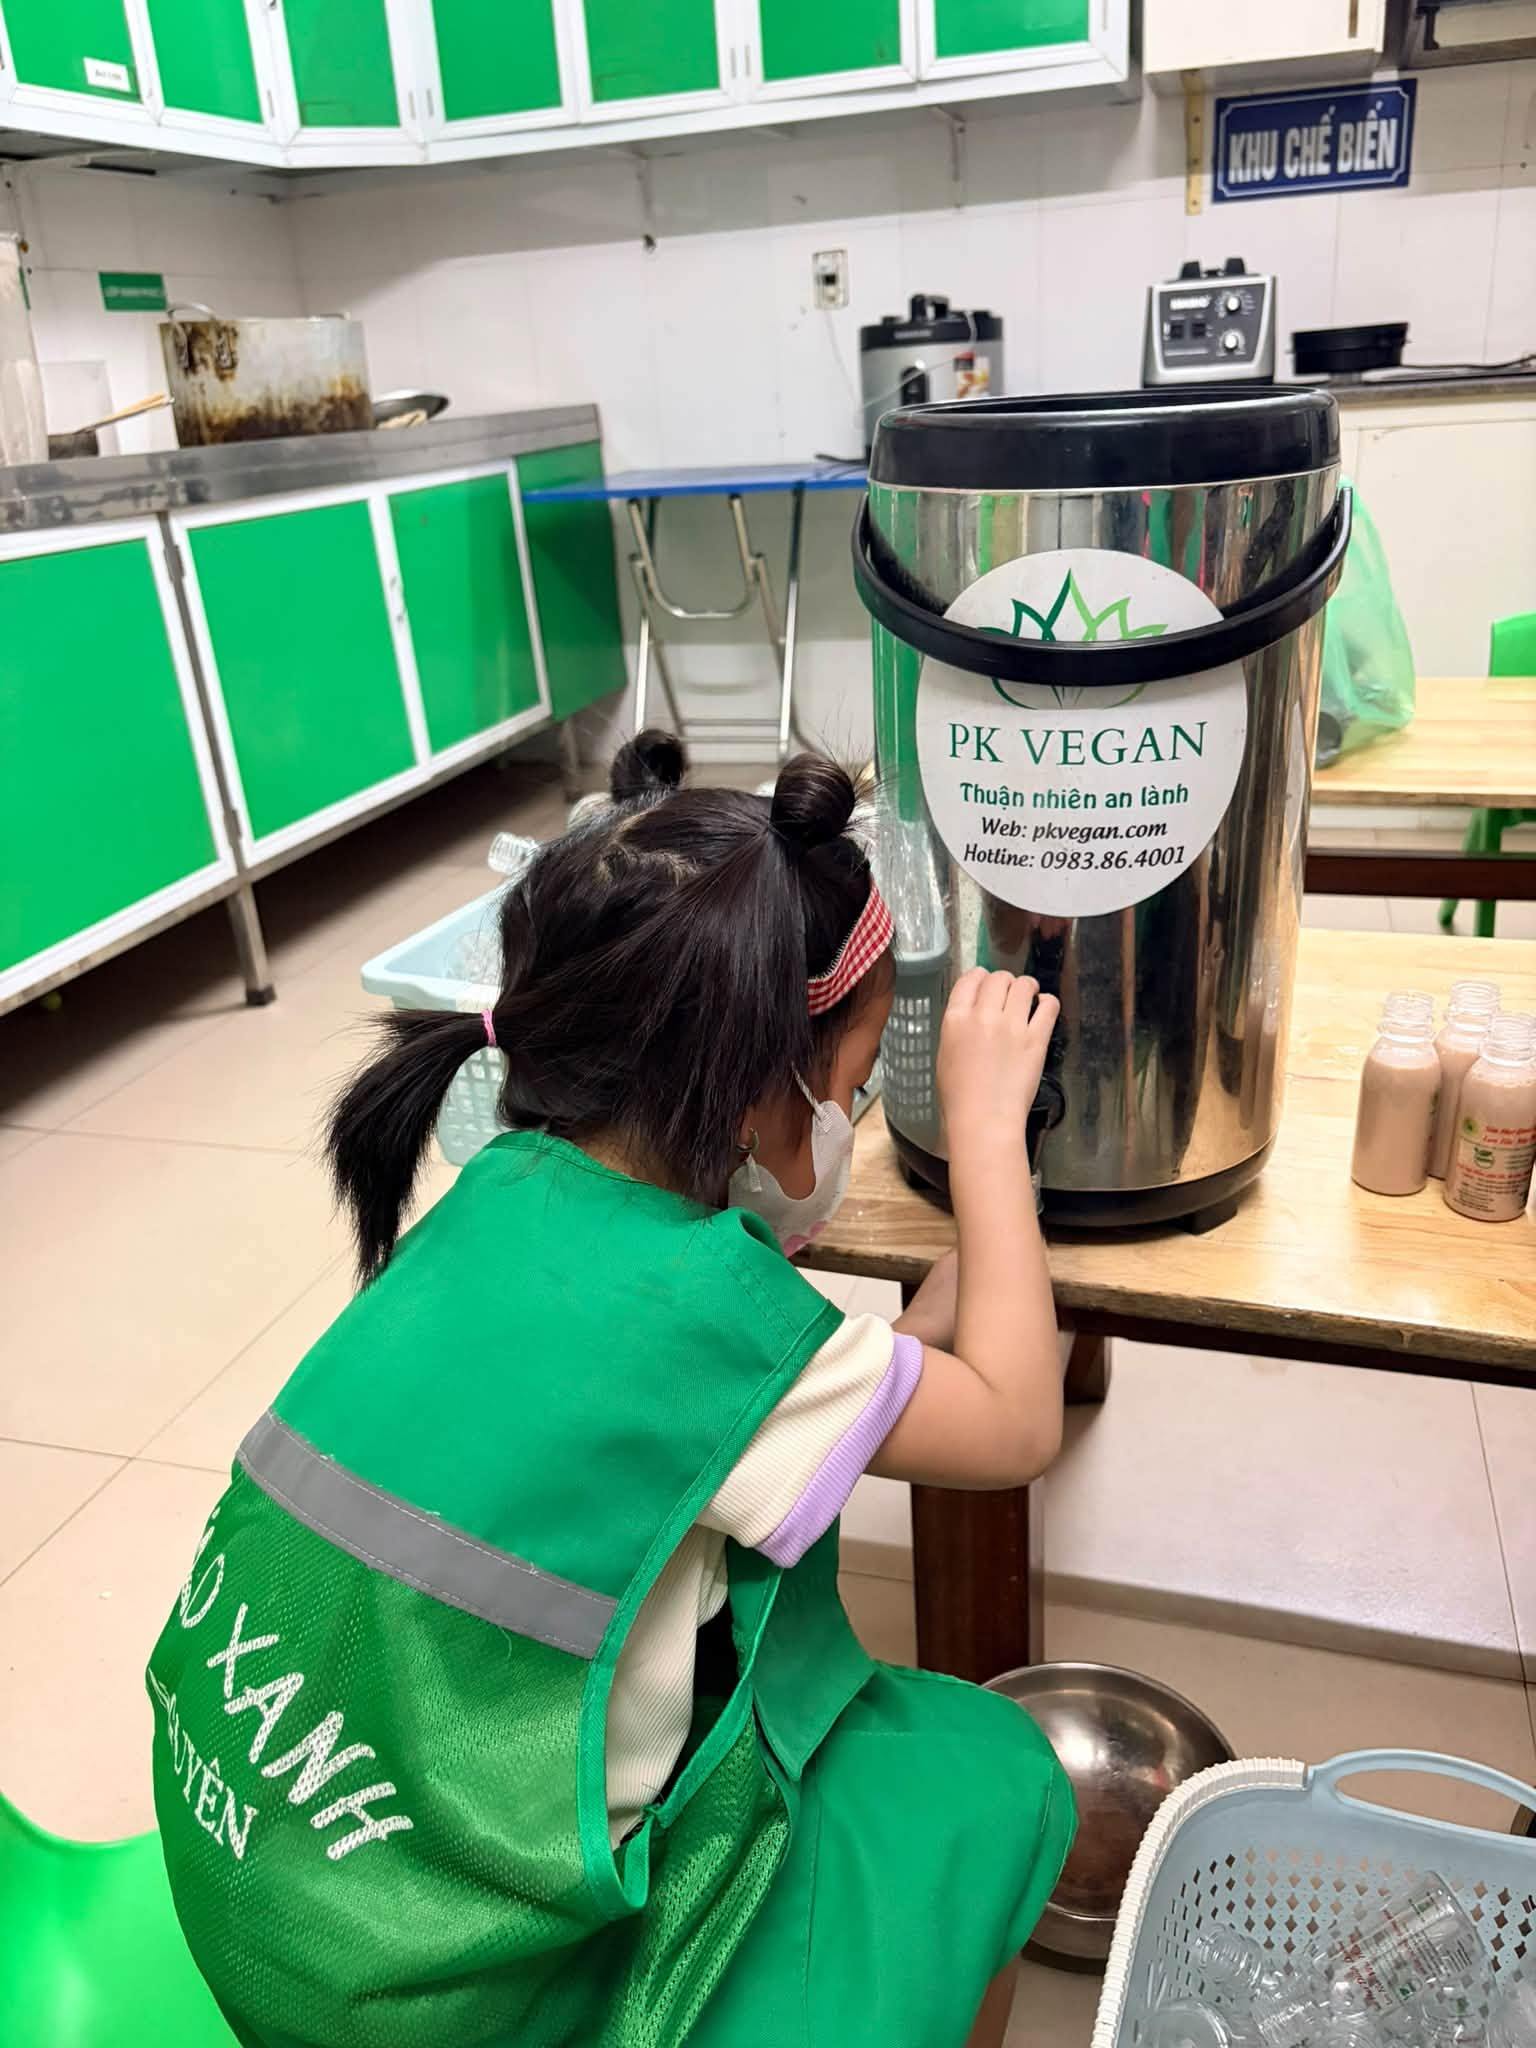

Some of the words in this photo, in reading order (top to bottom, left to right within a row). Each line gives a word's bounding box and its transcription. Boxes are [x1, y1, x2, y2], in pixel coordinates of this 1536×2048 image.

[1228, 130, 1279, 184] KHU
[1283, 105, 1336, 179] CHẾ
[1337, 100, 1399, 175] BIẾN
[948, 722, 1004, 764] PK
[1020, 721, 1208, 766] VEGAN
[960, 782, 1024, 812] Thuận
[1032, 787, 1097, 809] nhiên
[1105, 791, 1132, 809] an
[1140, 783, 1189, 808] lành
[981, 816, 1027, 839] Web:
[1032, 820, 1168, 844] pkvegan.com
[964, 844, 1035, 869] Hotline:
[1041, 845, 1184, 870] 0983.86.4001
[207, 1603, 414, 1861] XANH
